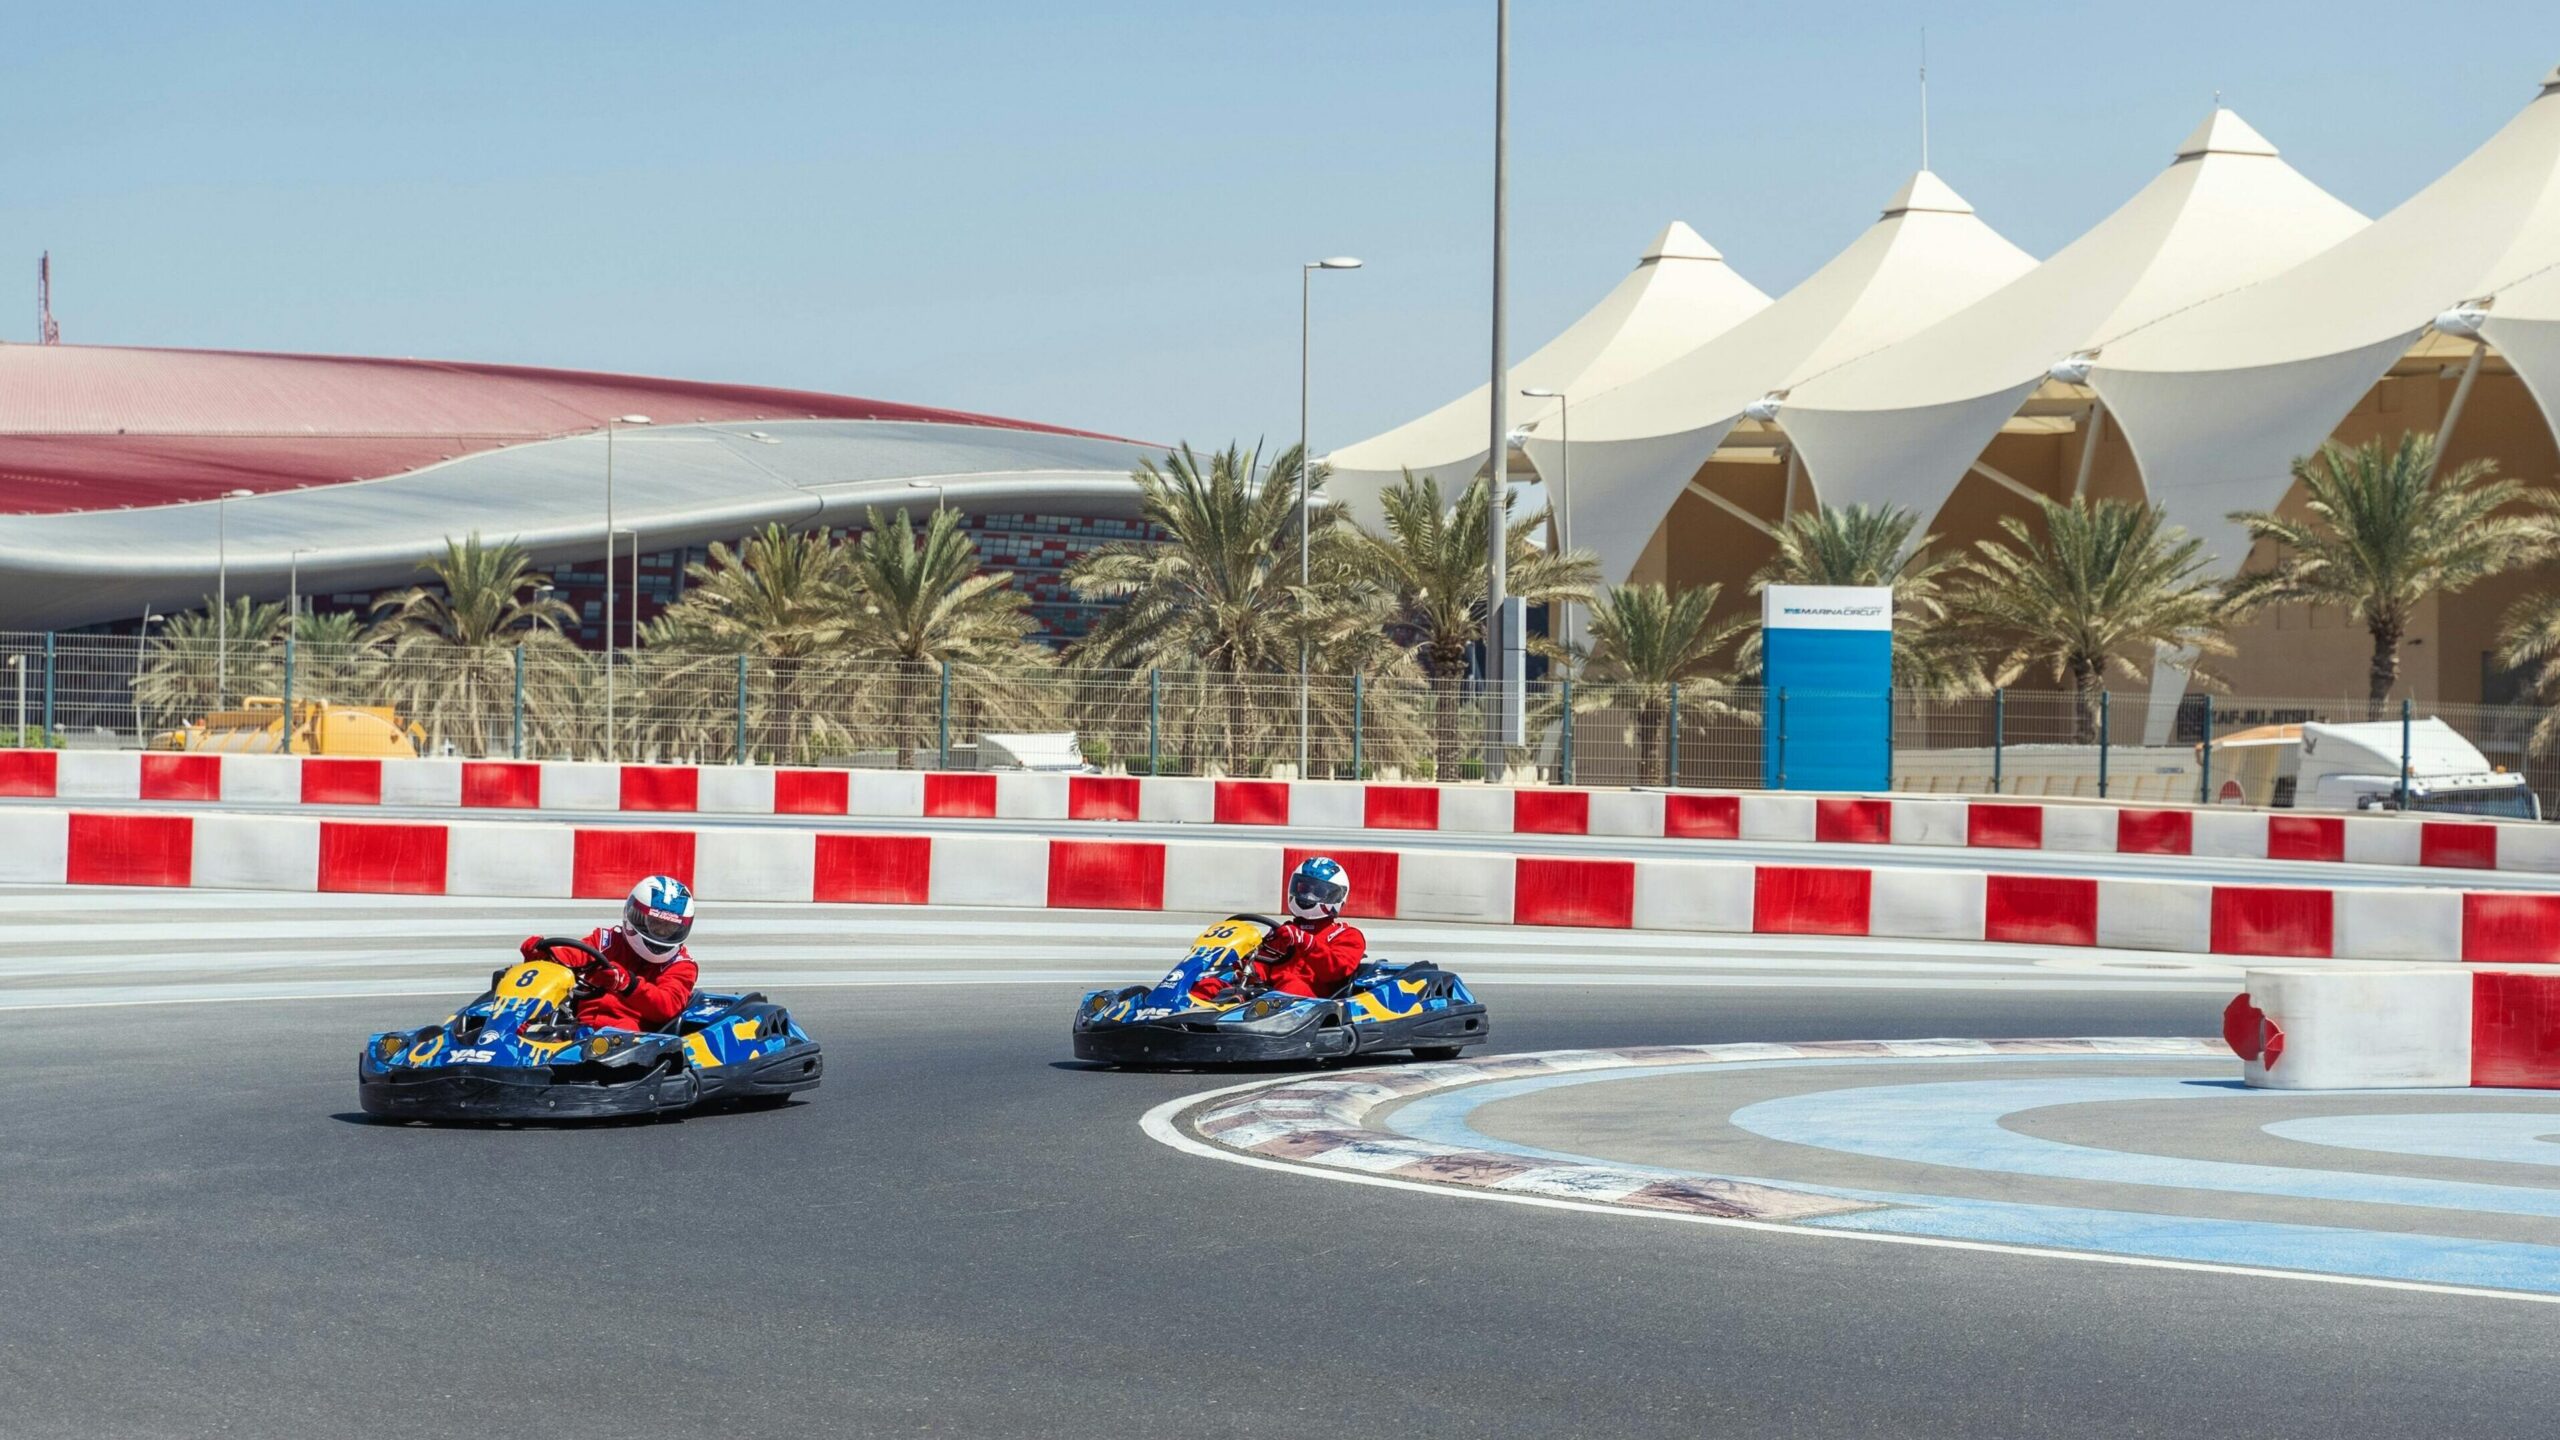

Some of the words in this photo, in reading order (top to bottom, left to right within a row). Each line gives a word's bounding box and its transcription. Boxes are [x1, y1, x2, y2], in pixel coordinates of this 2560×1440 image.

[1203, 926, 1239, 939] 36
[516, 969, 539, 987] 8
[1132, 1007, 1173, 1021] YAS
[446, 1049, 496, 1063] YAS
